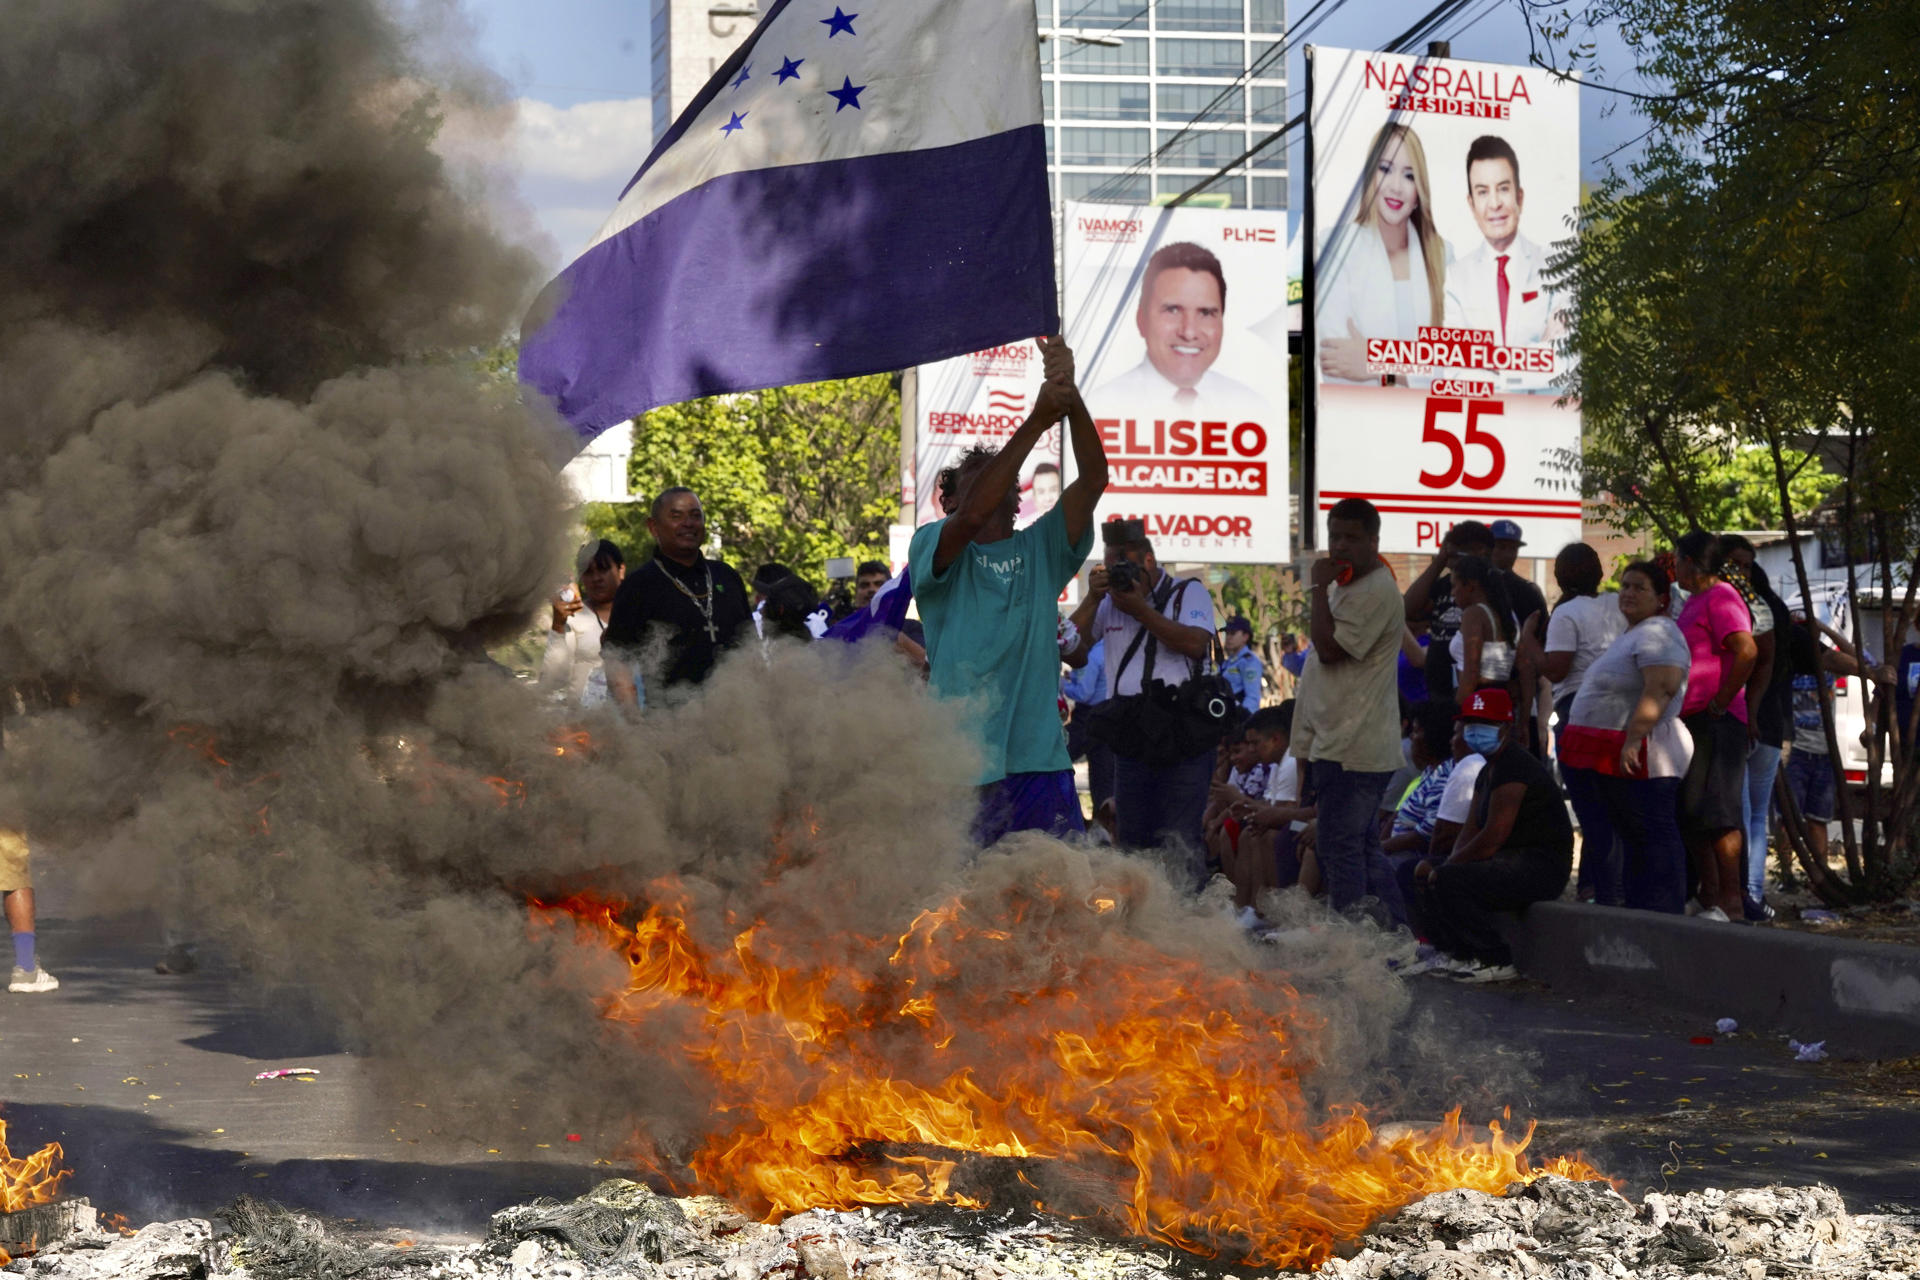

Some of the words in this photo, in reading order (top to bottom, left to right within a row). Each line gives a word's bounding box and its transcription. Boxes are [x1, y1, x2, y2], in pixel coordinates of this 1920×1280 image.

[1365, 60, 1531, 104] NASRALLA
[1386, 93, 1510, 120] PRESIDENTE
[1078, 217, 1143, 232] ¡VAMOS!
[1419, 327, 1494, 343] ABOGADA
[1368, 340, 1466, 367] SANDRA
[1470, 346, 1553, 371] FLORES
[1432, 380, 1493, 397] CASILLA
[929, 412, 1025, 430] BERNARDO
[1095, 419, 1267, 457] ELISEO
[1419, 397, 1506, 490] 55
[1108, 465, 1215, 489] ALCALDE
[1218, 467, 1261, 491] D.C
[1472, 694, 1485, 710] LA
